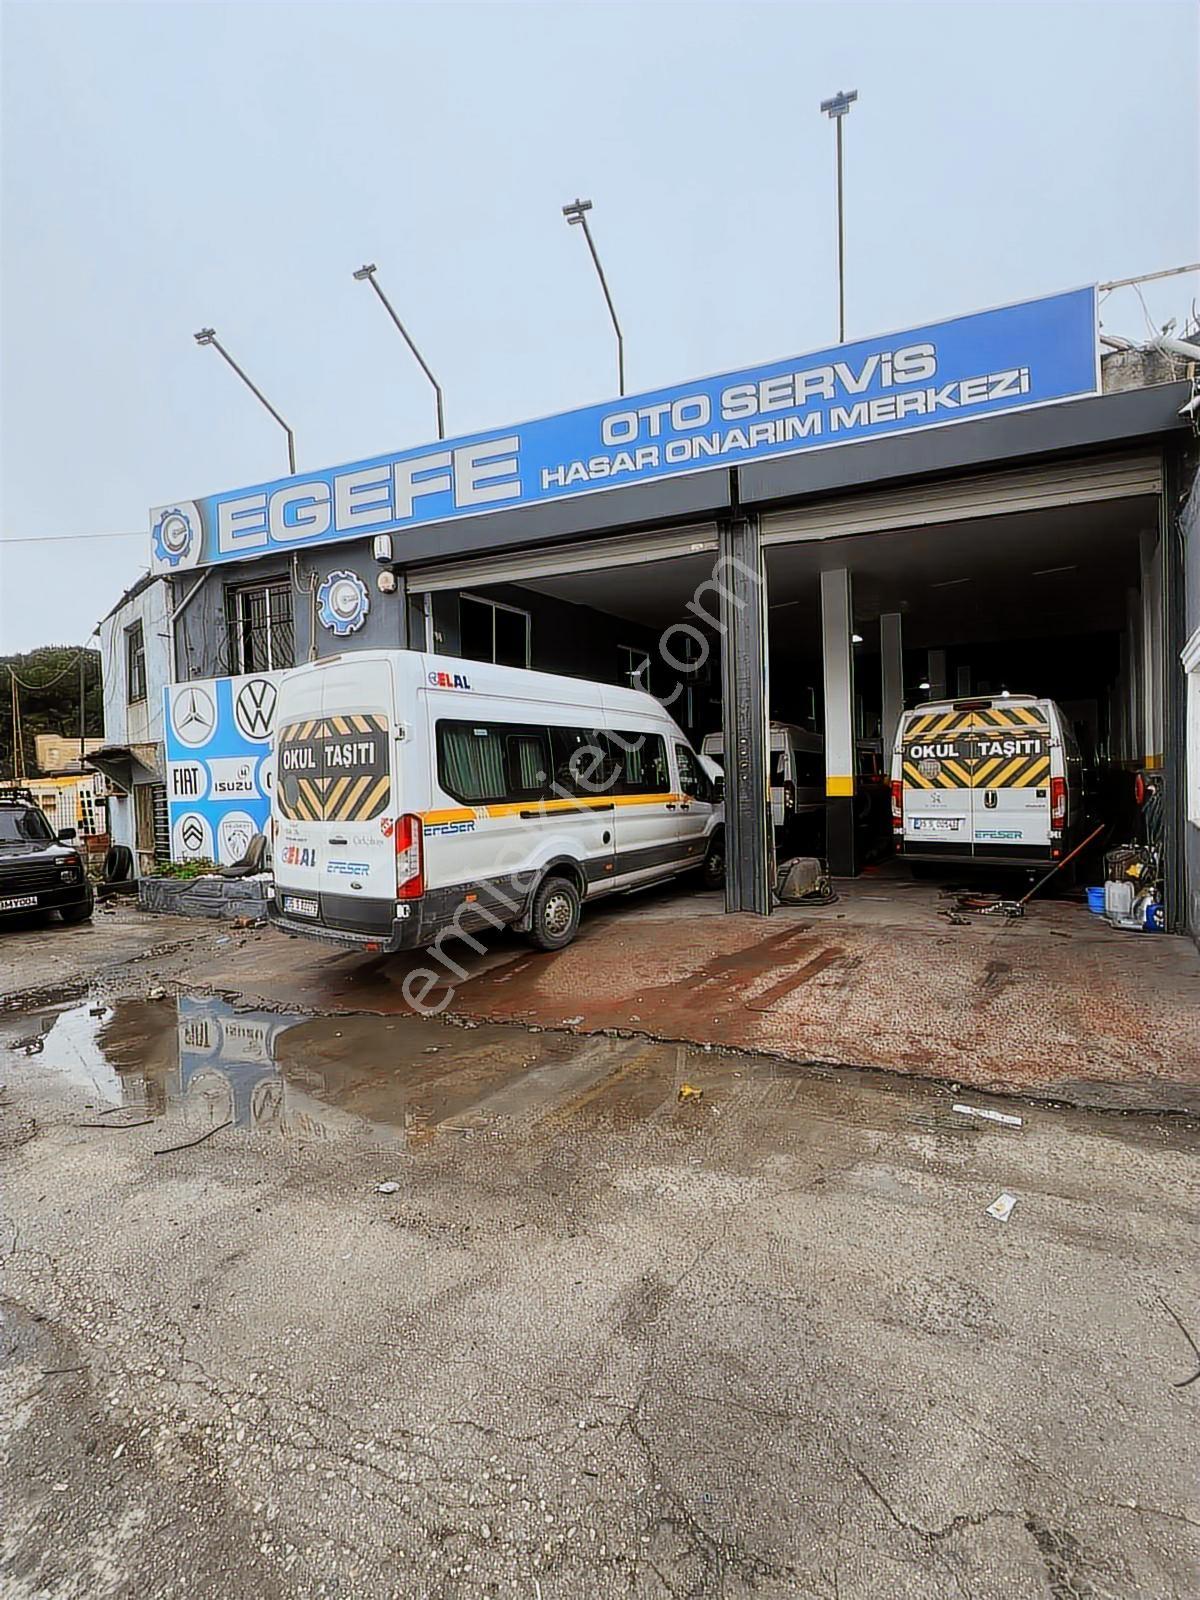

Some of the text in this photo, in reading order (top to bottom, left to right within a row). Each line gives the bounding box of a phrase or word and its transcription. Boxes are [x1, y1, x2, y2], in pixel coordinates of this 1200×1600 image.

[601, 393, 710, 447] OTO
[541, 442, 659, 489] HASAR
[665, 411, 821, 464] ONARIM
[217, 434, 521, 553] EGEFE
[283, 742, 376, 770] OKUL TAŞITI
[910, 739, 1041, 759] OKUL TAŞITI
[173, 767, 198, 795] FIAT
[214, 781, 253, 792] ISUZU
